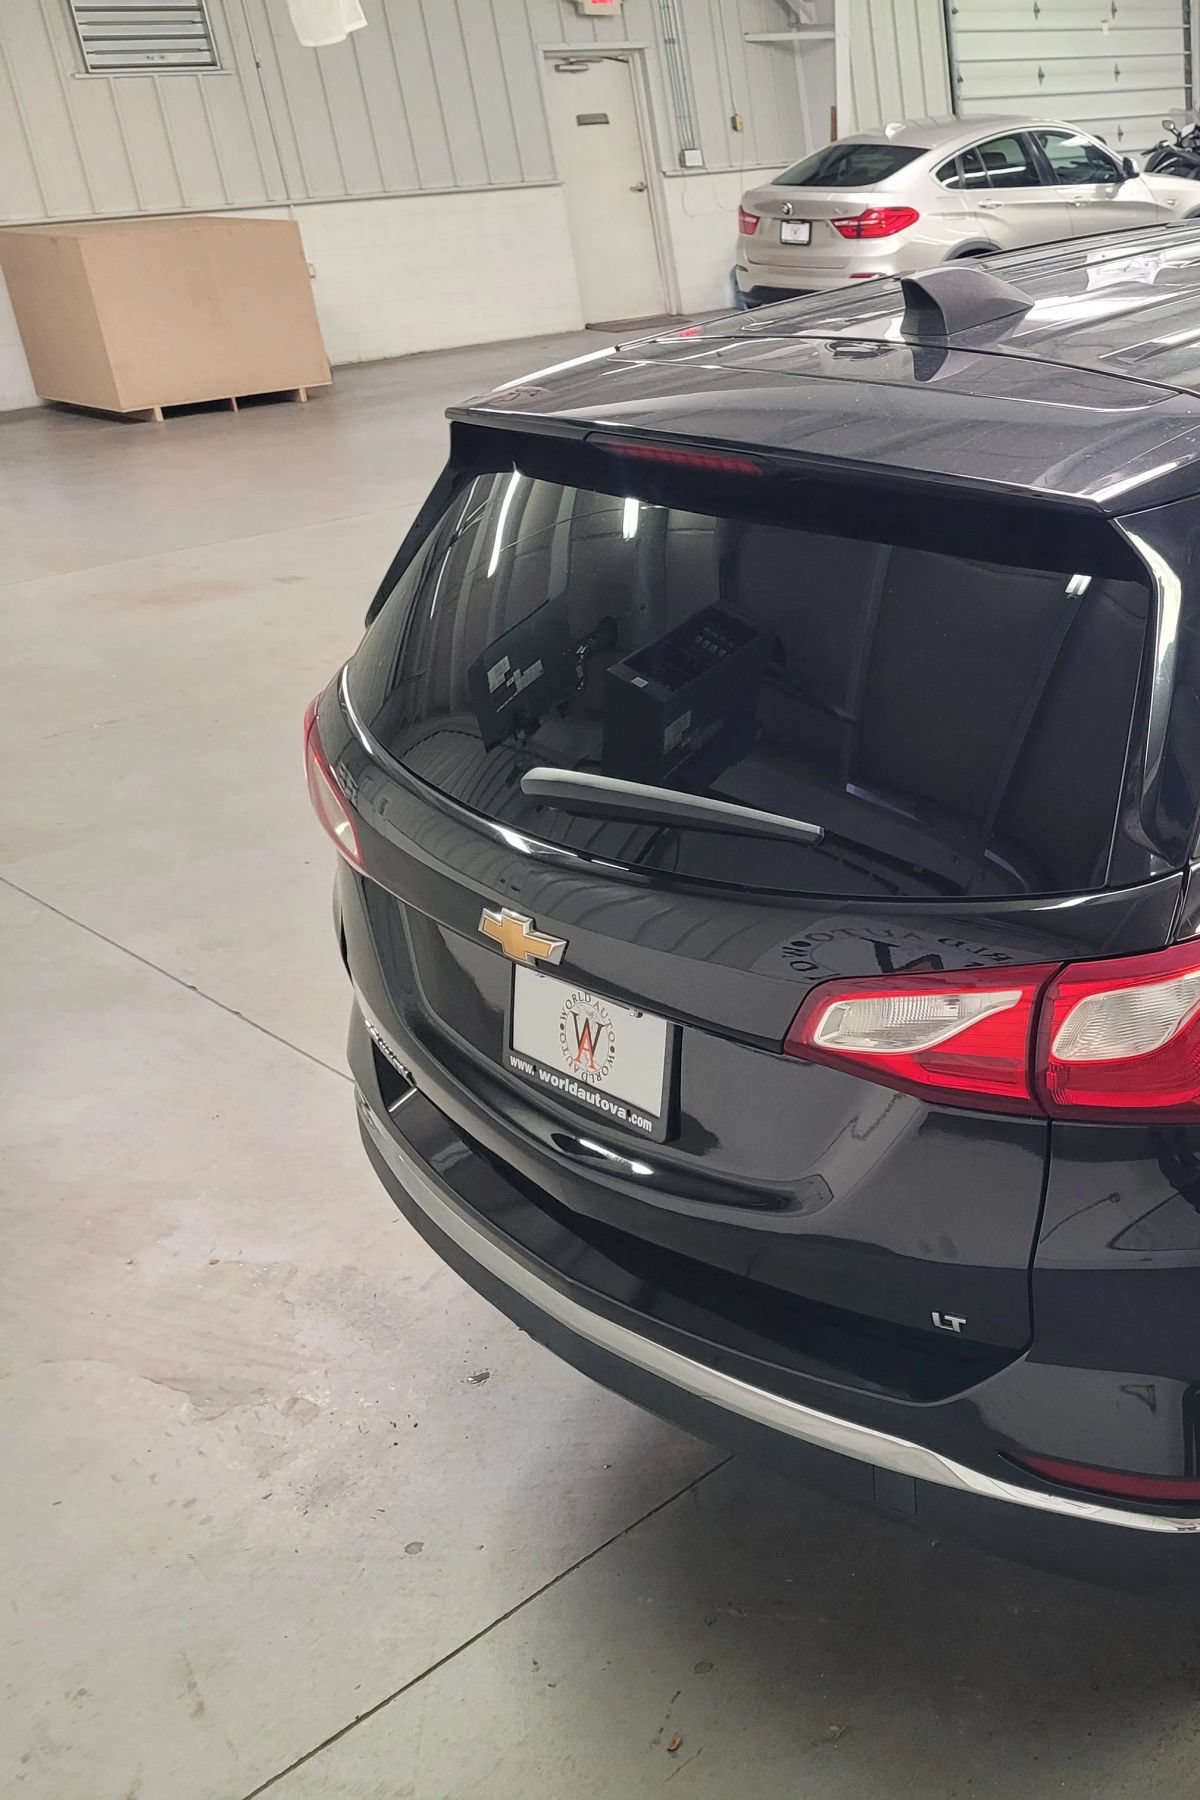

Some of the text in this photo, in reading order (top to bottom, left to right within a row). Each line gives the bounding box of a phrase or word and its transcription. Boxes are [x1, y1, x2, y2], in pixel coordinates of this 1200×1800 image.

[560, 991, 616, 1043] WORLD AUTO
[931, 1311, 967, 1333] LT
